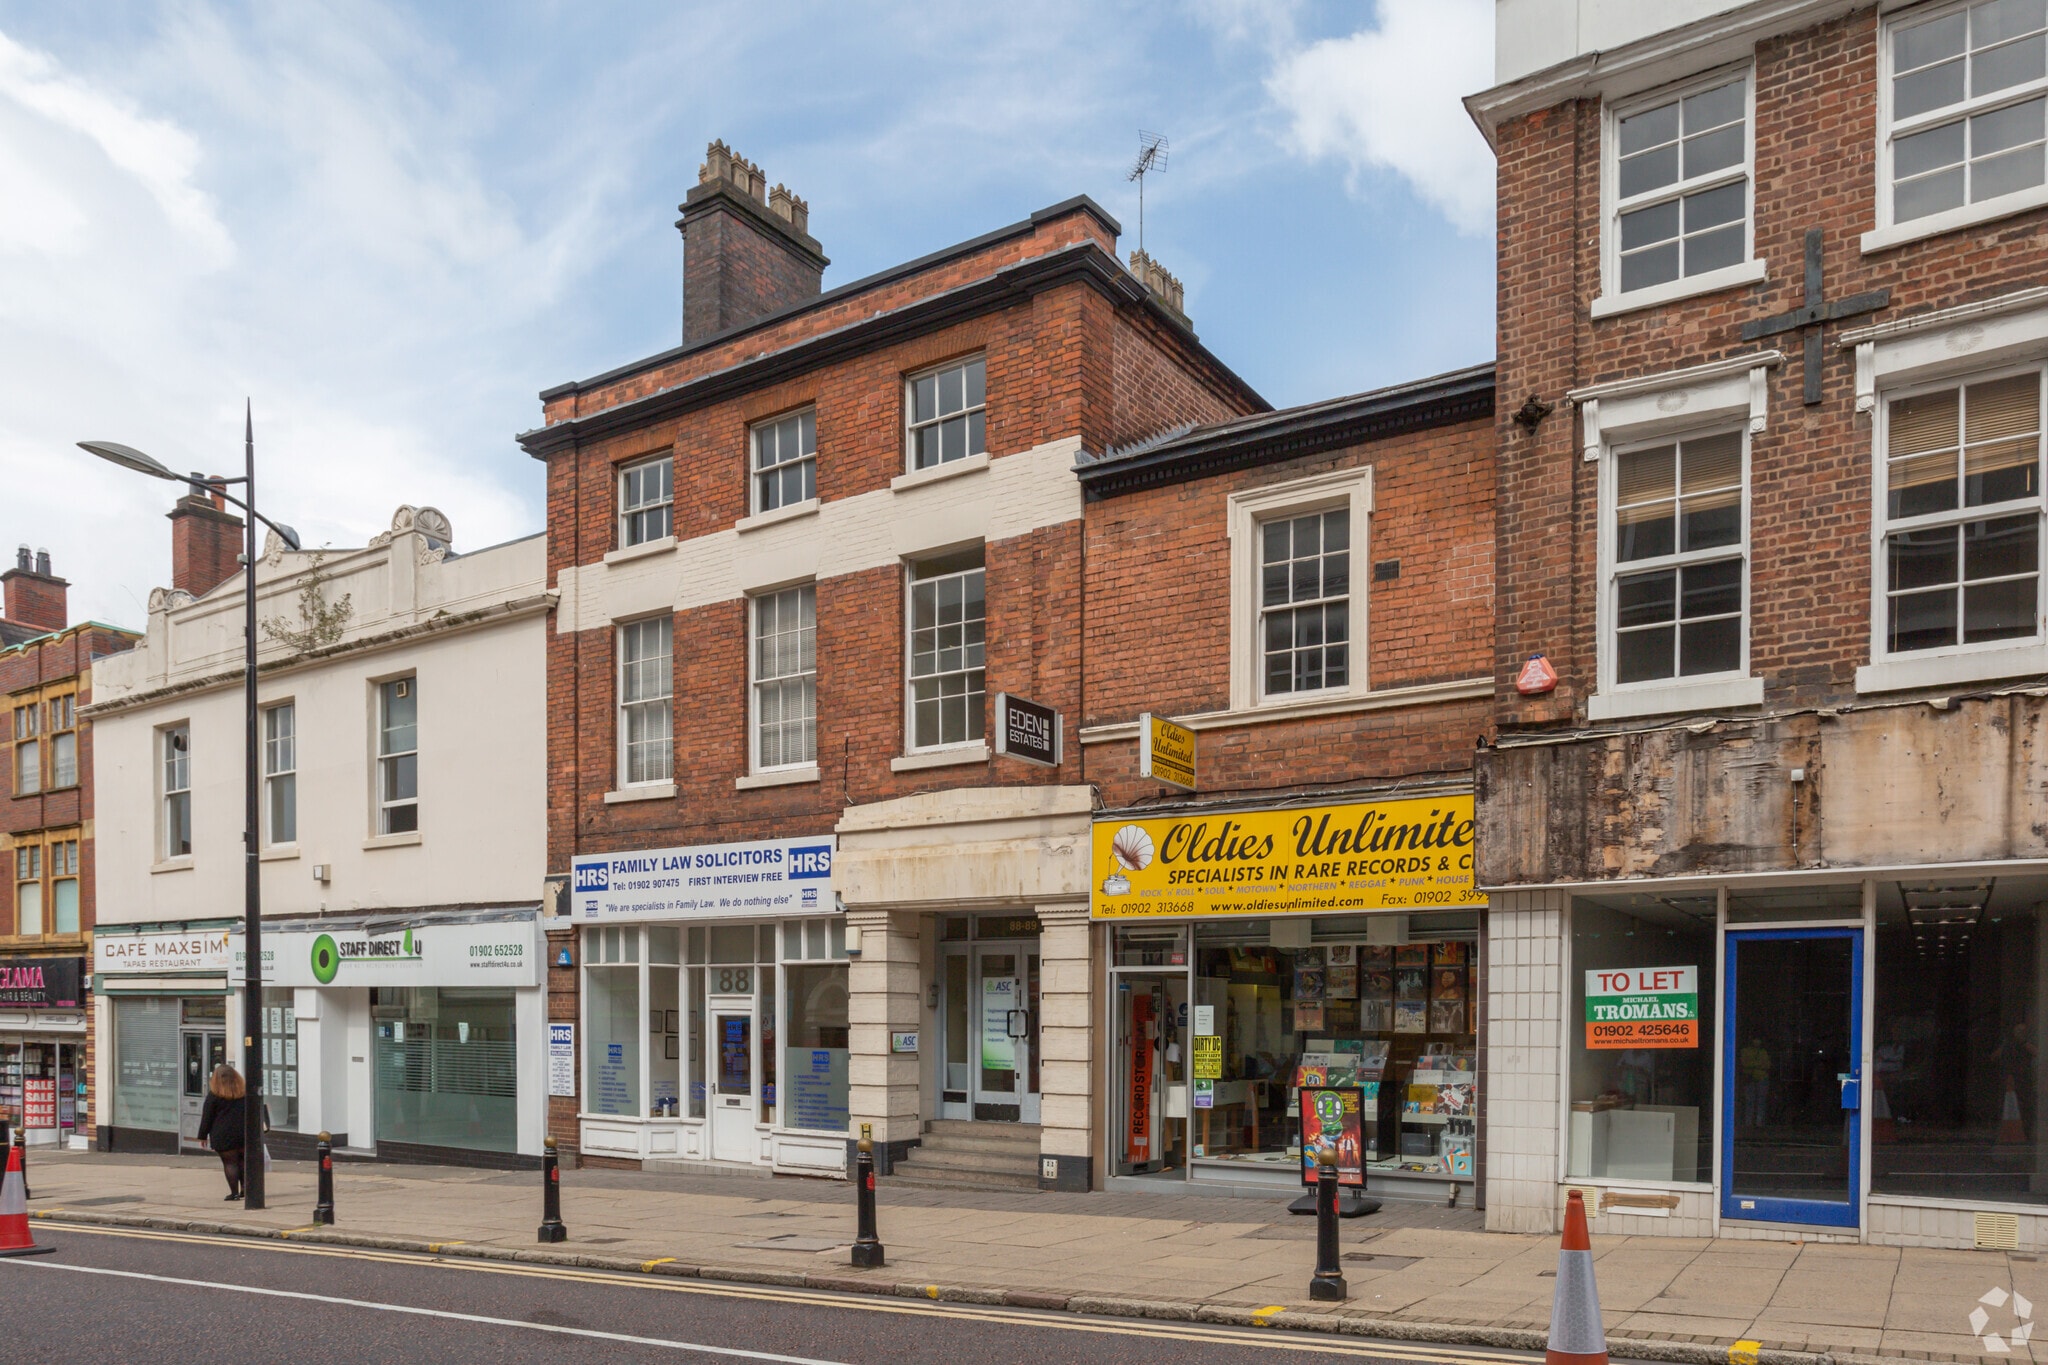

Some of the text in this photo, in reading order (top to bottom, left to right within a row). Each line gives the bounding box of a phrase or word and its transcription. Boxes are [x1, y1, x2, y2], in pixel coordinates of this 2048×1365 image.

[1009, 708, 1042, 735] EDEN
[1009, 729, 1043, 749] ESTATES
[1161, 722, 1185, 744] Oldies
[1153, 736, 1193, 764] Unlimited
[1154, 765, 1171, 779] 01902
[1160, 809, 1475, 864] Oldies Unlimite
[612, 848, 783, 874] FAMILY LAW SOLICITORS
[789, 851, 830, 873] HRS
[1168, 854, 1474, 884] SPECIALISTS IN RARE RECORDS & C
[576, 868, 608, 887] HRS
[613, 872, 783, 891] Tel: 01902 907475 FIRST INTERVIEW FREE
[1140, 888, 1162, 897] ROCK
[1176, 888, 1195, 896] ROLL
[1205, 886, 1226, 895] SOUL
[1236, 885, 1277, 894] MOTOWN
[1287, 881, 1337, 892] NORTHERN
[1348, 878, 1387, 889] REGGAE
[1399, 877, 1426, 887] PUNK
[1435, 874, 1470, 885] HOUSE
[802, 890, 817, 899] HRS
[631, 902, 665, 913] specialists
[667, 901, 674, 909] in
[675, 900, 698, 911] Family
[700, 899, 715, 908] Law.
[719, 898, 731, 907] We
[732, 896, 742, 907] do
[743, 896, 772, 907] nothing
[773, 894, 793, 904] else"
[1100, 904, 1116, 915] Tel:
[1121, 903, 1151, 914] 01902
[1156, 902, 1194, 913] 313668
[1210, 896, 1364, 912] www.oldiesunlimited.com
[1381, 894, 1407, 905] Fax:
[1413, 890, 1452, 904] 01902
[1009, 920, 1037, 931] 88-89
[105, 938, 147, 957] CAFÉ
[340, 940, 367, 957] STAFF
[369, 940, 401, 956] DIRECT
[469, 944, 523, 956] 01902 652528
[123, 960, 147, 968] TAPAS
[149, 959, 202, 968] RESTAURANT
[469, 960, 523, 968] www.staffdirect4u.co.uk
[719, 968, 750, 992] 88
[996, 981, 1012, 991] ASC
[1597, 970, 1685, 992] TO LET
[20, 991, 46, 1001] BEAUTY
[1622, 996, 1659, 1004] MICHAEL
[1594, 1002, 1688, 1020] TROMANS
[551, 1029, 571, 1041] HRS
[1594, 1024, 1690, 1037] 01902 425646
[903, 1036, 916, 1046] ASC
[1195, 1037, 1221, 1051] DIRTY DC
[1594, 1036, 1689, 1045] www.michaeltromans.co.uk
[25, 1080, 55, 1090] SALE
[25, 1092, 55, 1102] SALE
[25, 1104, 55, 1114] SALE
[1132, 1084, 1145, 1135] RECORD
[1325, 1101, 1333, 1115] 2
[25, 1116, 55, 1126] SALE
